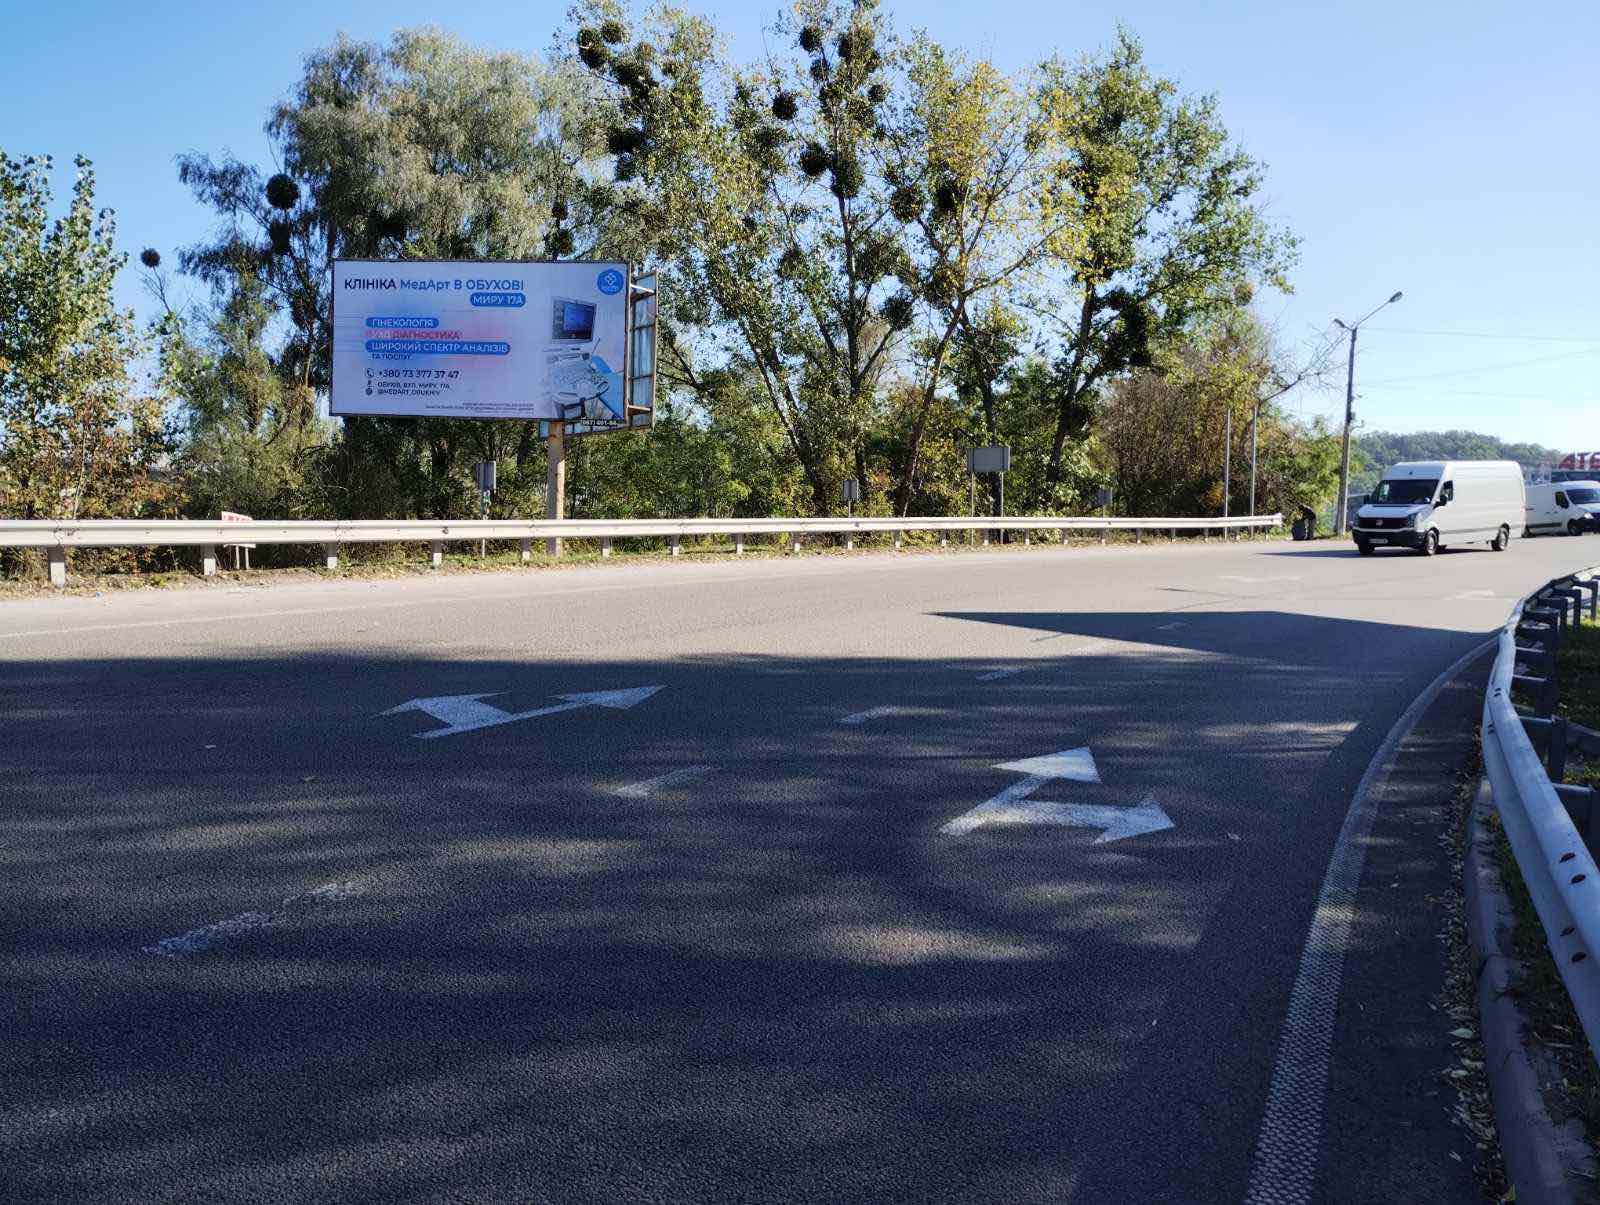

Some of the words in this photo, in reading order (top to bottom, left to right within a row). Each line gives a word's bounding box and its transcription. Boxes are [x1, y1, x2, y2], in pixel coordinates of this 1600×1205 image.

[345, 279, 396, 289] КЛІНІКА
[401, 279, 449, 292] МедАрт
[454, 280, 462, 289] В
[466, 280, 524, 290] ОБУХОВІ
[473, 295, 503, 304] МИРУ
[372, 341, 421, 351] ШИРОКИЙ
[424, 343, 460, 352] СПЕКТР
[462, 344, 508, 353] АНАЛІЗІВ
[379, 369, 400, 378] +380
[402, 369, 413, 378] 73
[416, 370, 432, 378] 377
[434, 370, 445, 379] 37
[448, 370, 459, 379] 47
